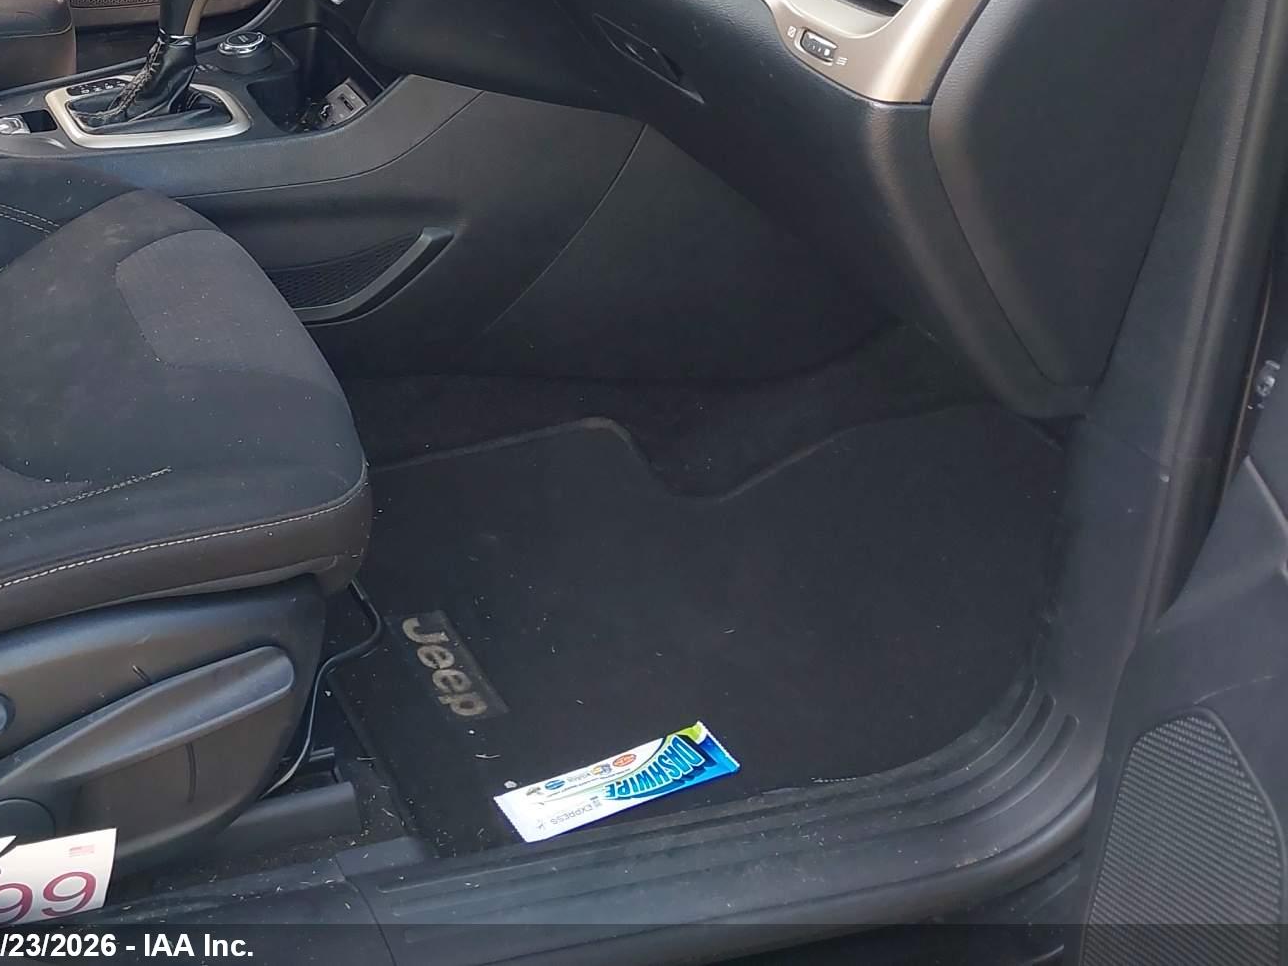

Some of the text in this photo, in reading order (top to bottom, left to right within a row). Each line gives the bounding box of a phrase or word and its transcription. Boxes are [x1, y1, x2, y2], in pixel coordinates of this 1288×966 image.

[402, 617, 488, 716] Jeep
[603, 734, 706, 800] DASHWIPE
[550, 803, 594, 826] EXPRESS
